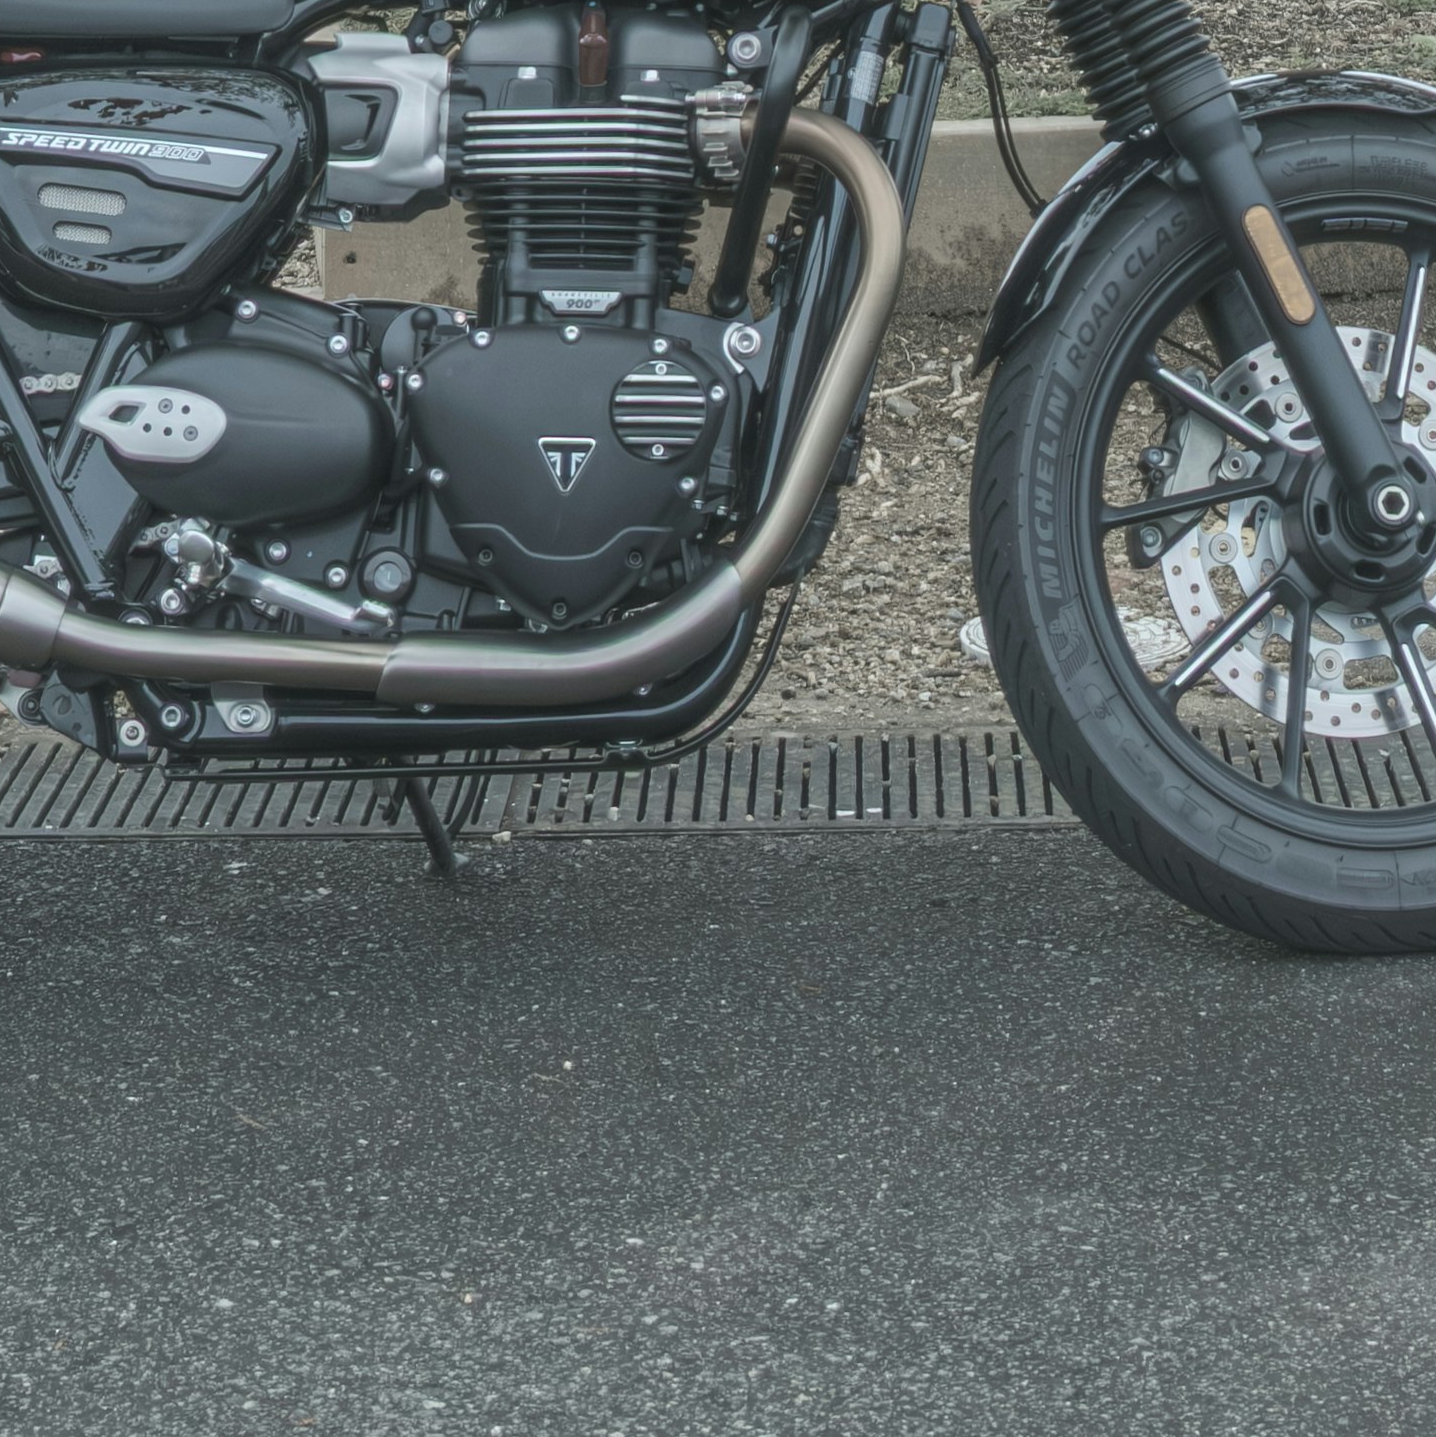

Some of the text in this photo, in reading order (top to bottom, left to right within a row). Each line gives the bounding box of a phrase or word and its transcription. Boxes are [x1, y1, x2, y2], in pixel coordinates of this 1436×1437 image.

[1, 131, 205, 161] SPEED TWIN 900
[1034, 208, 1191, 599] MICHELIN ROAD CLAS
